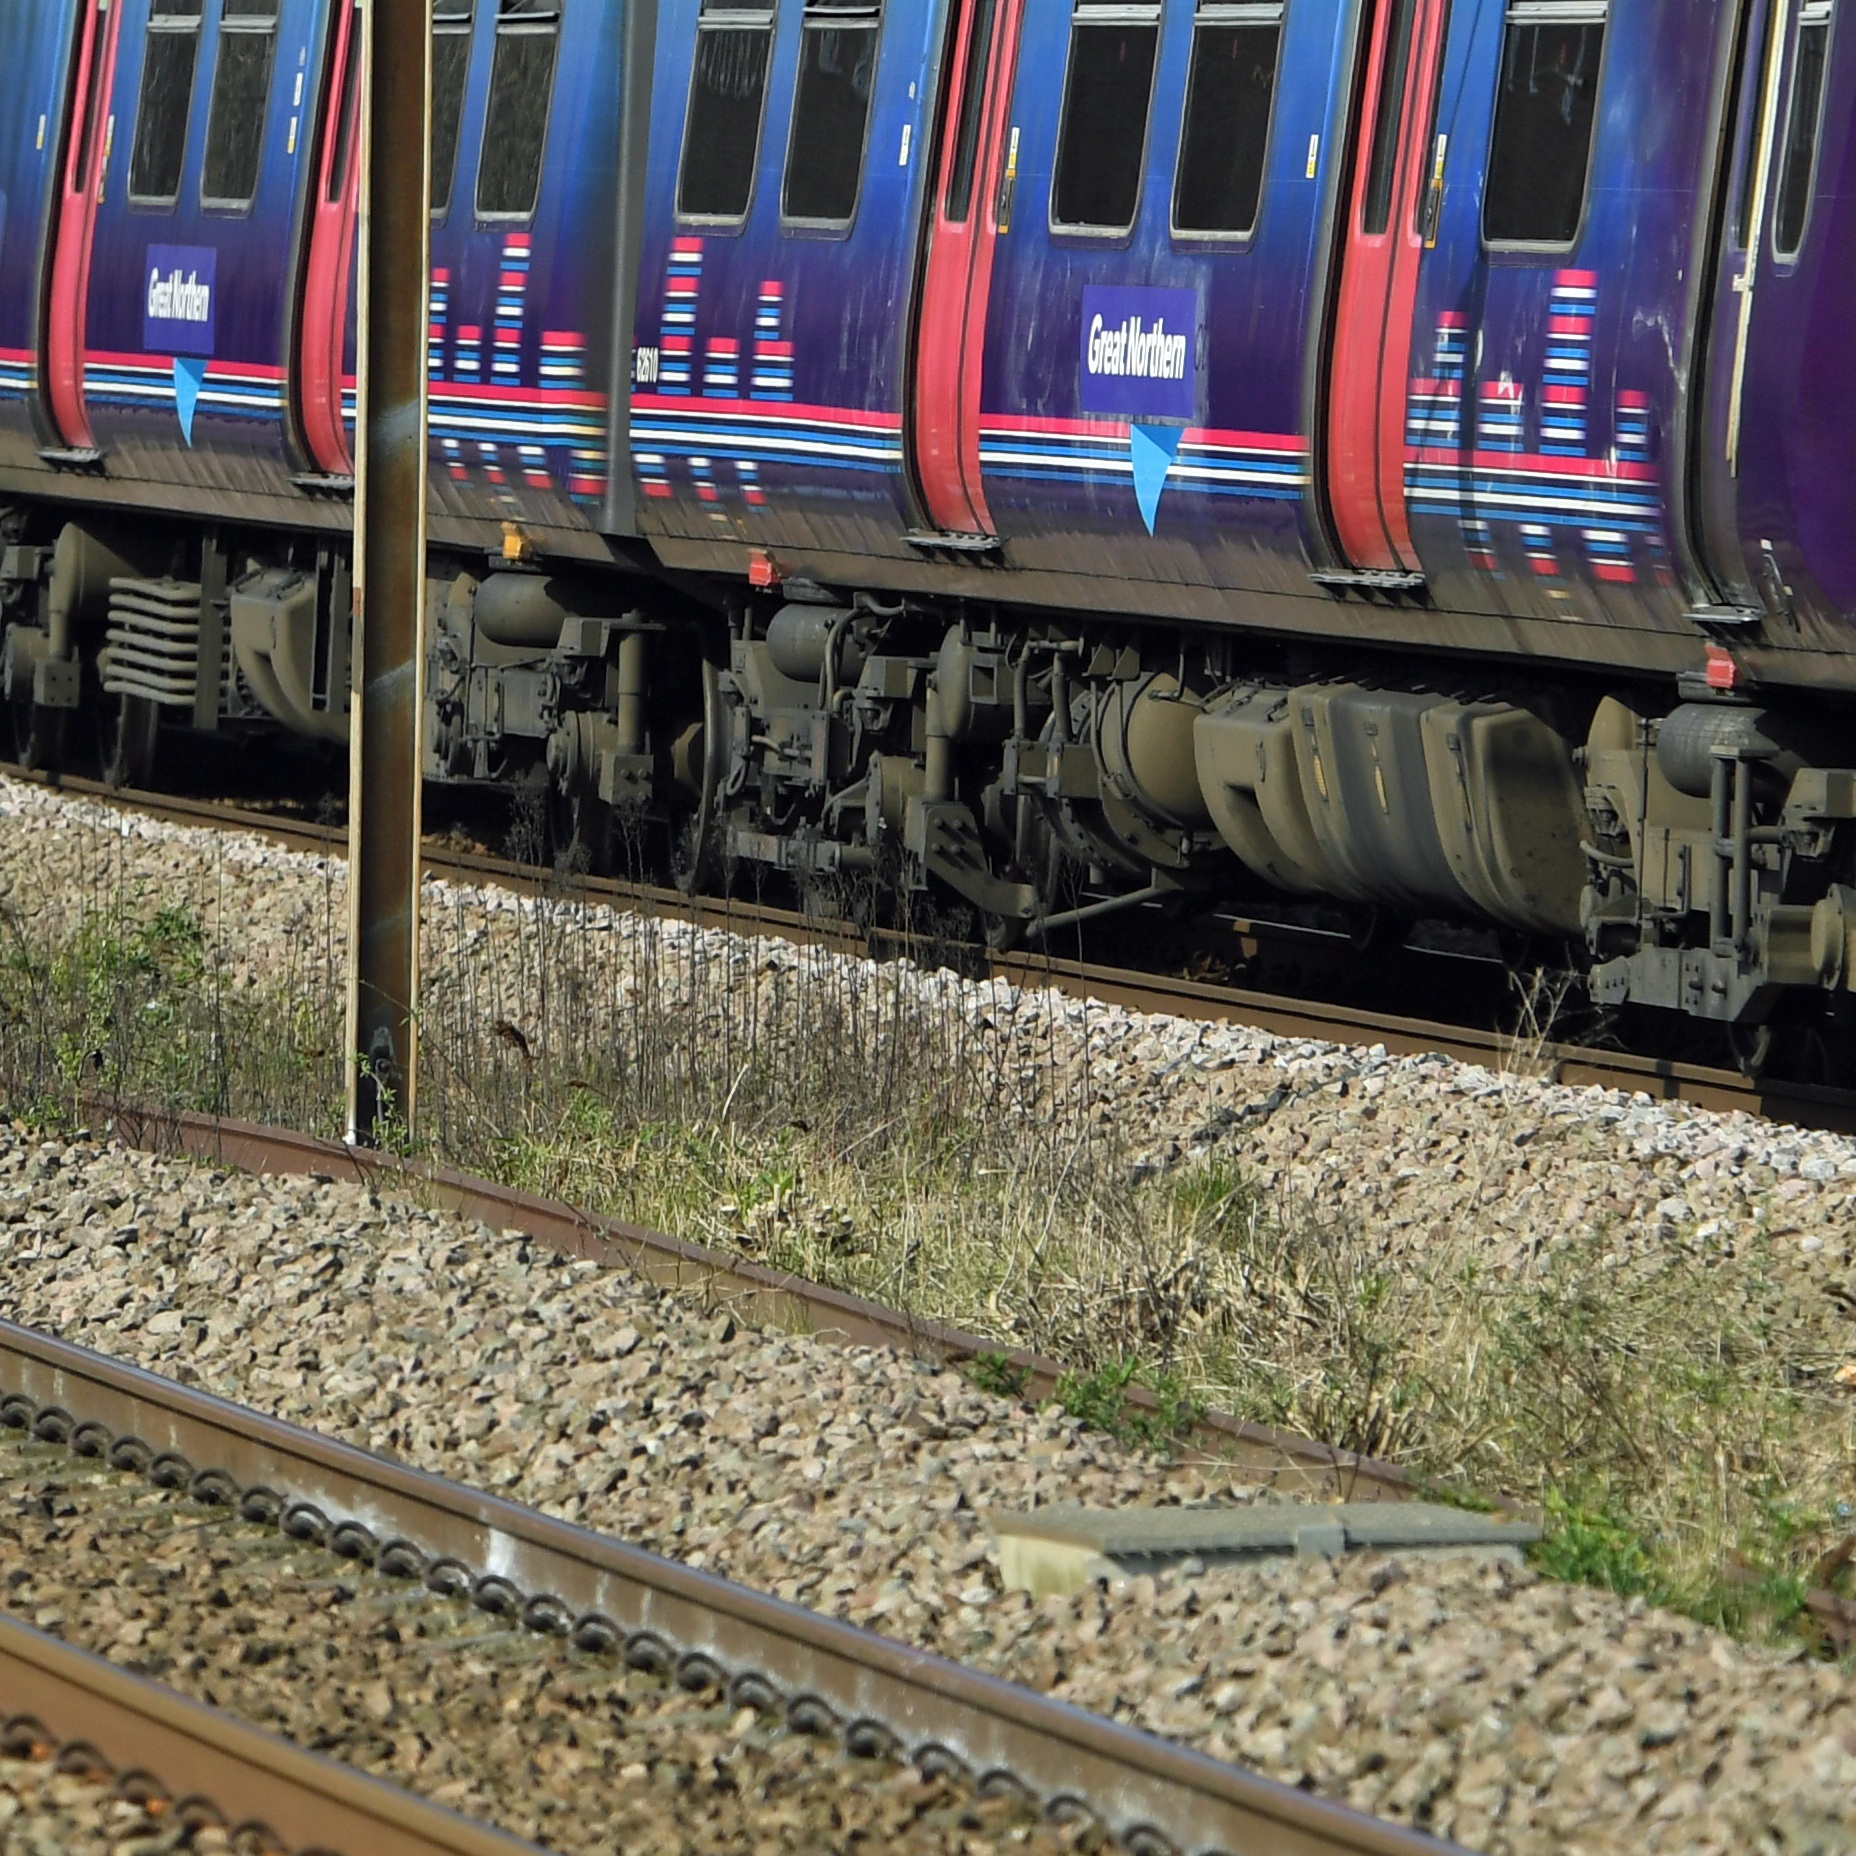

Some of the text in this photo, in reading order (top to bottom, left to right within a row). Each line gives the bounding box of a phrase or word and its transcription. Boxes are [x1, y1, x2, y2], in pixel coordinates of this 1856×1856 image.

[636, 346, 659, 383] 62610
[1087, 313, 1186, 379] Great Northern
